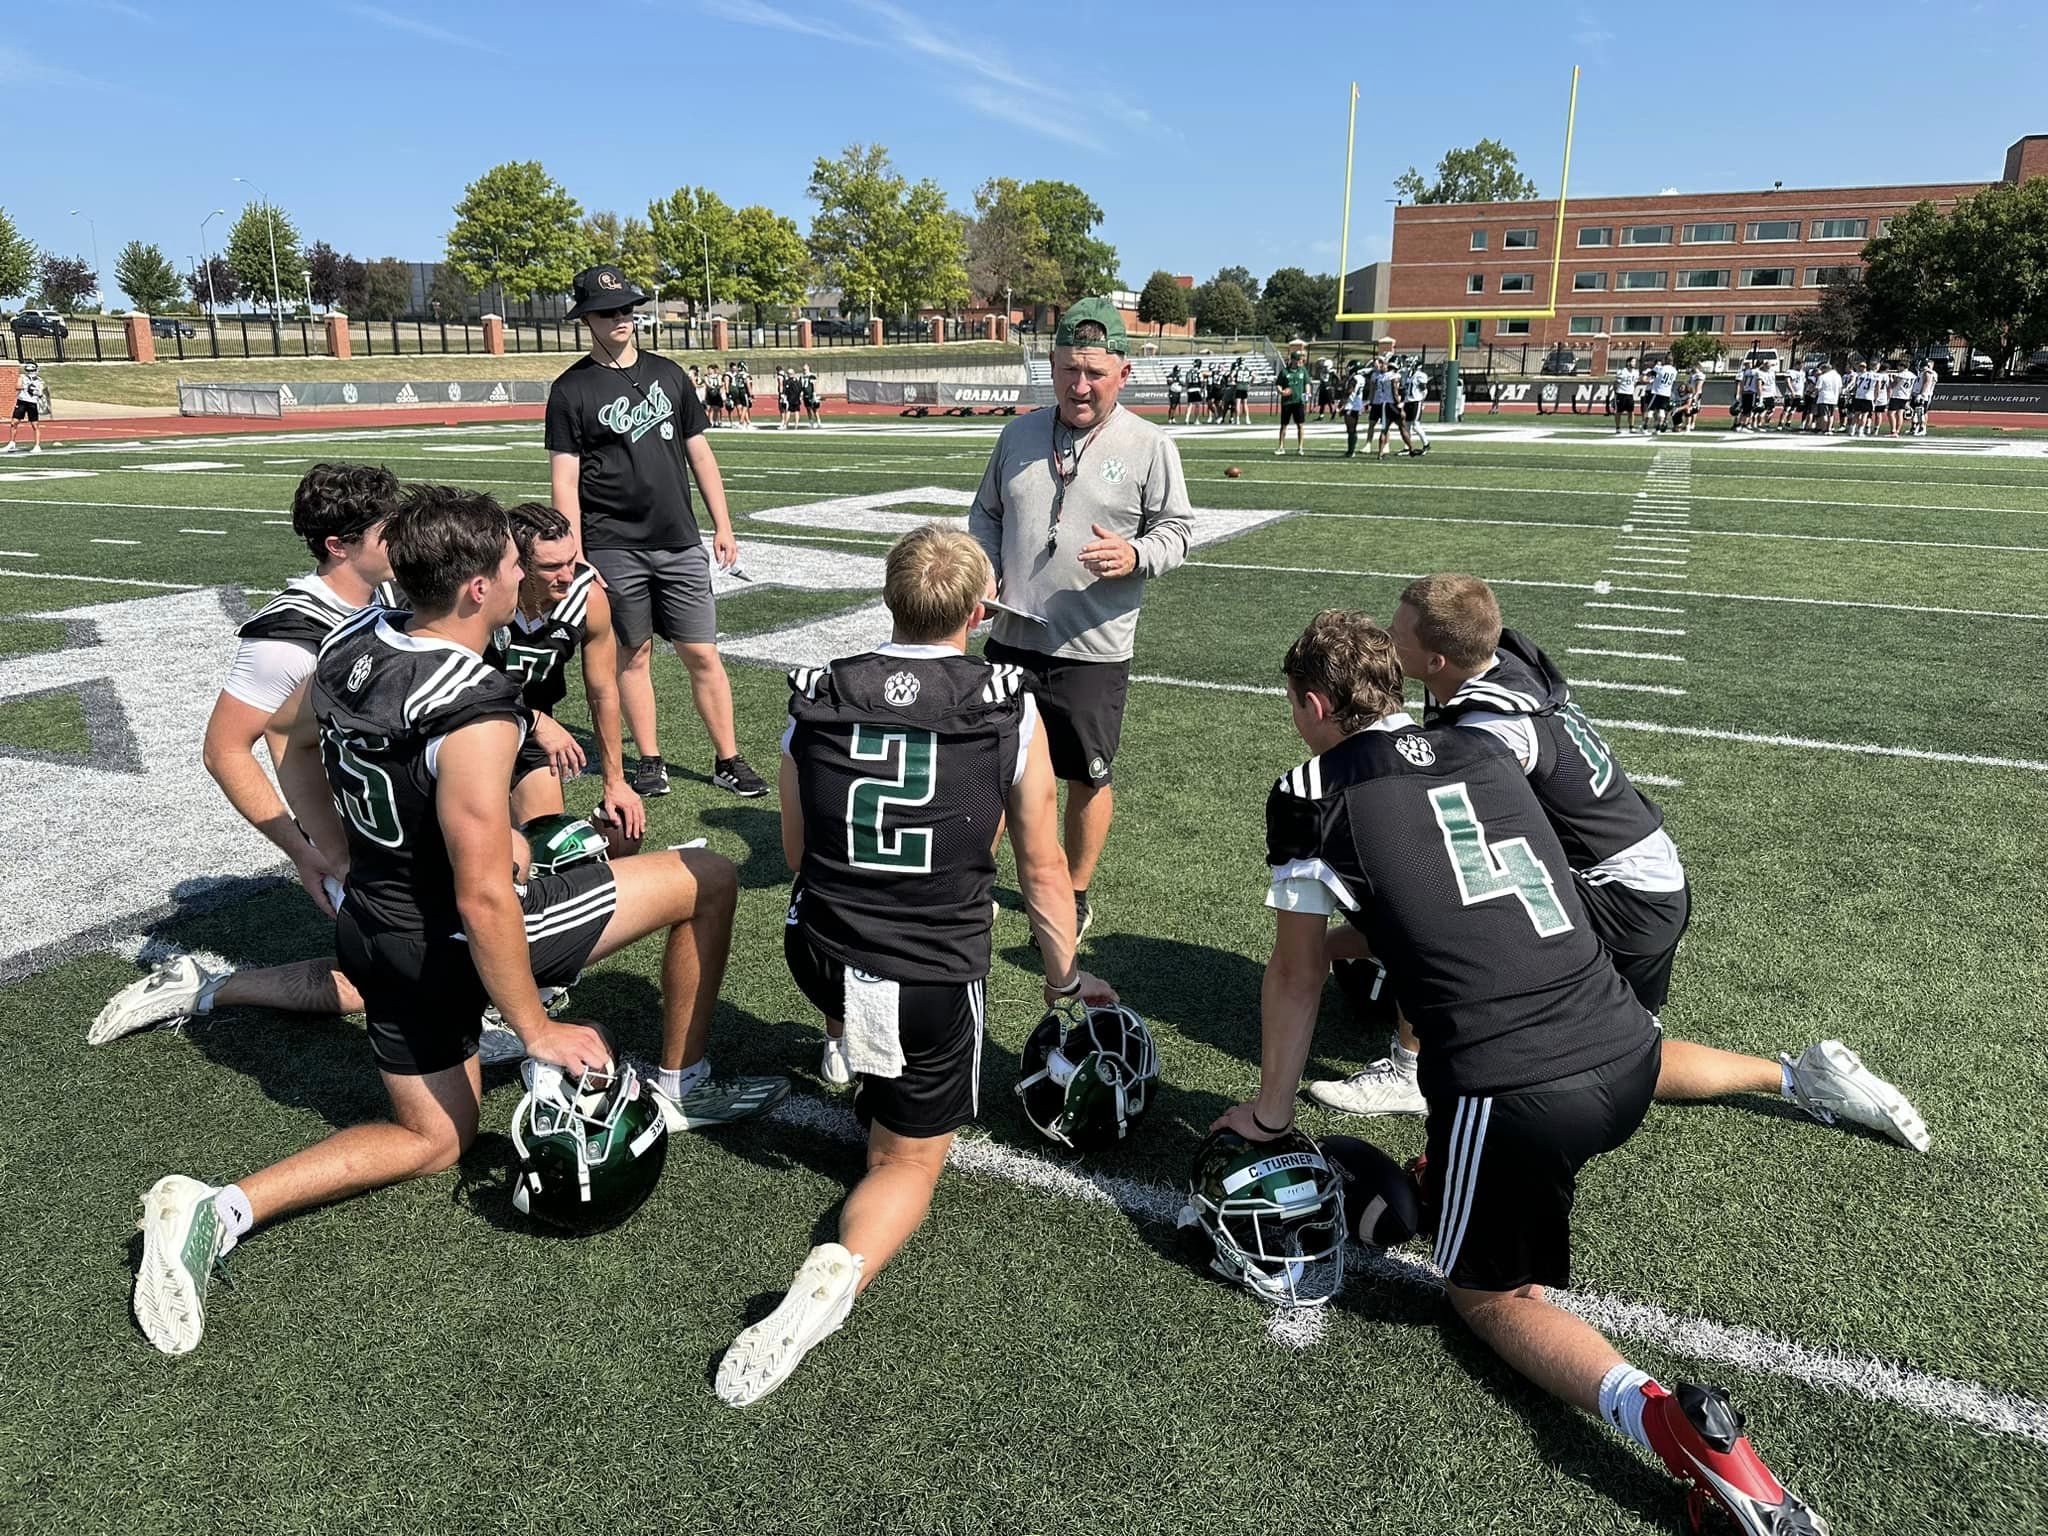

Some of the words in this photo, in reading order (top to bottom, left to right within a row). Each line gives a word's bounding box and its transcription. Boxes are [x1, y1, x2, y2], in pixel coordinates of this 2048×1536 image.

[598, 380, 674, 434] Cats
[1983, 395, 2041, 403] UNIVERSITY
[846, 723, 937, 873] 2
[1427, 782, 1575, 939] 4
[1247, 1166, 1263, 1179] C.
[1263, 1154, 1314, 1172] TURNER
